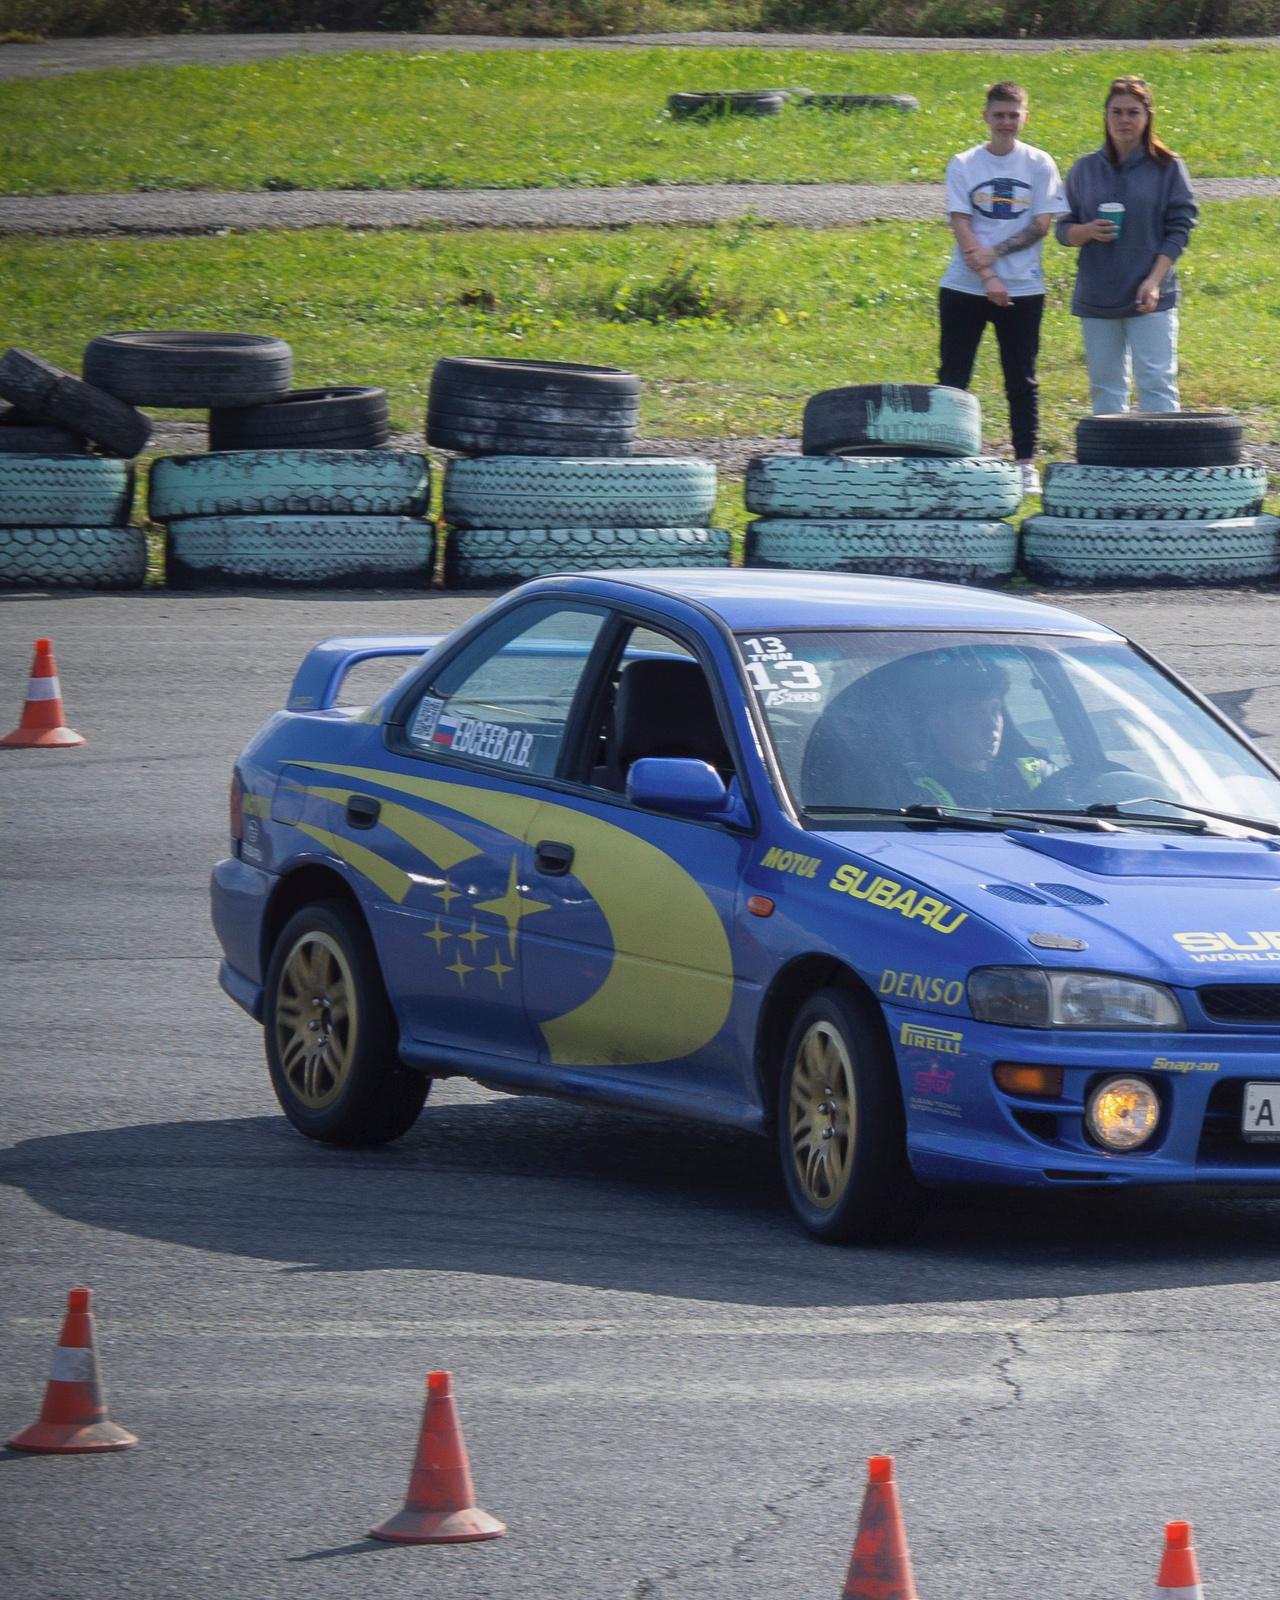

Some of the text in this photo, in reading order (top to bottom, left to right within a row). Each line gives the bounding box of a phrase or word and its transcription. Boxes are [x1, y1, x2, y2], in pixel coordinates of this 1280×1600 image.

[742, 636, 787, 654] 13
[747, 652, 793, 662] TMN
[745, 660, 823, 691] 13
[760, 847, 823, 879] MOTUL
[829, 864, 969, 934] SUBARU
[879, 969, 963, 1006] DENSO
[900, 1022, 963, 1054] PIRELLI
[1151, 1057, 1220, 1073] Snap-on
